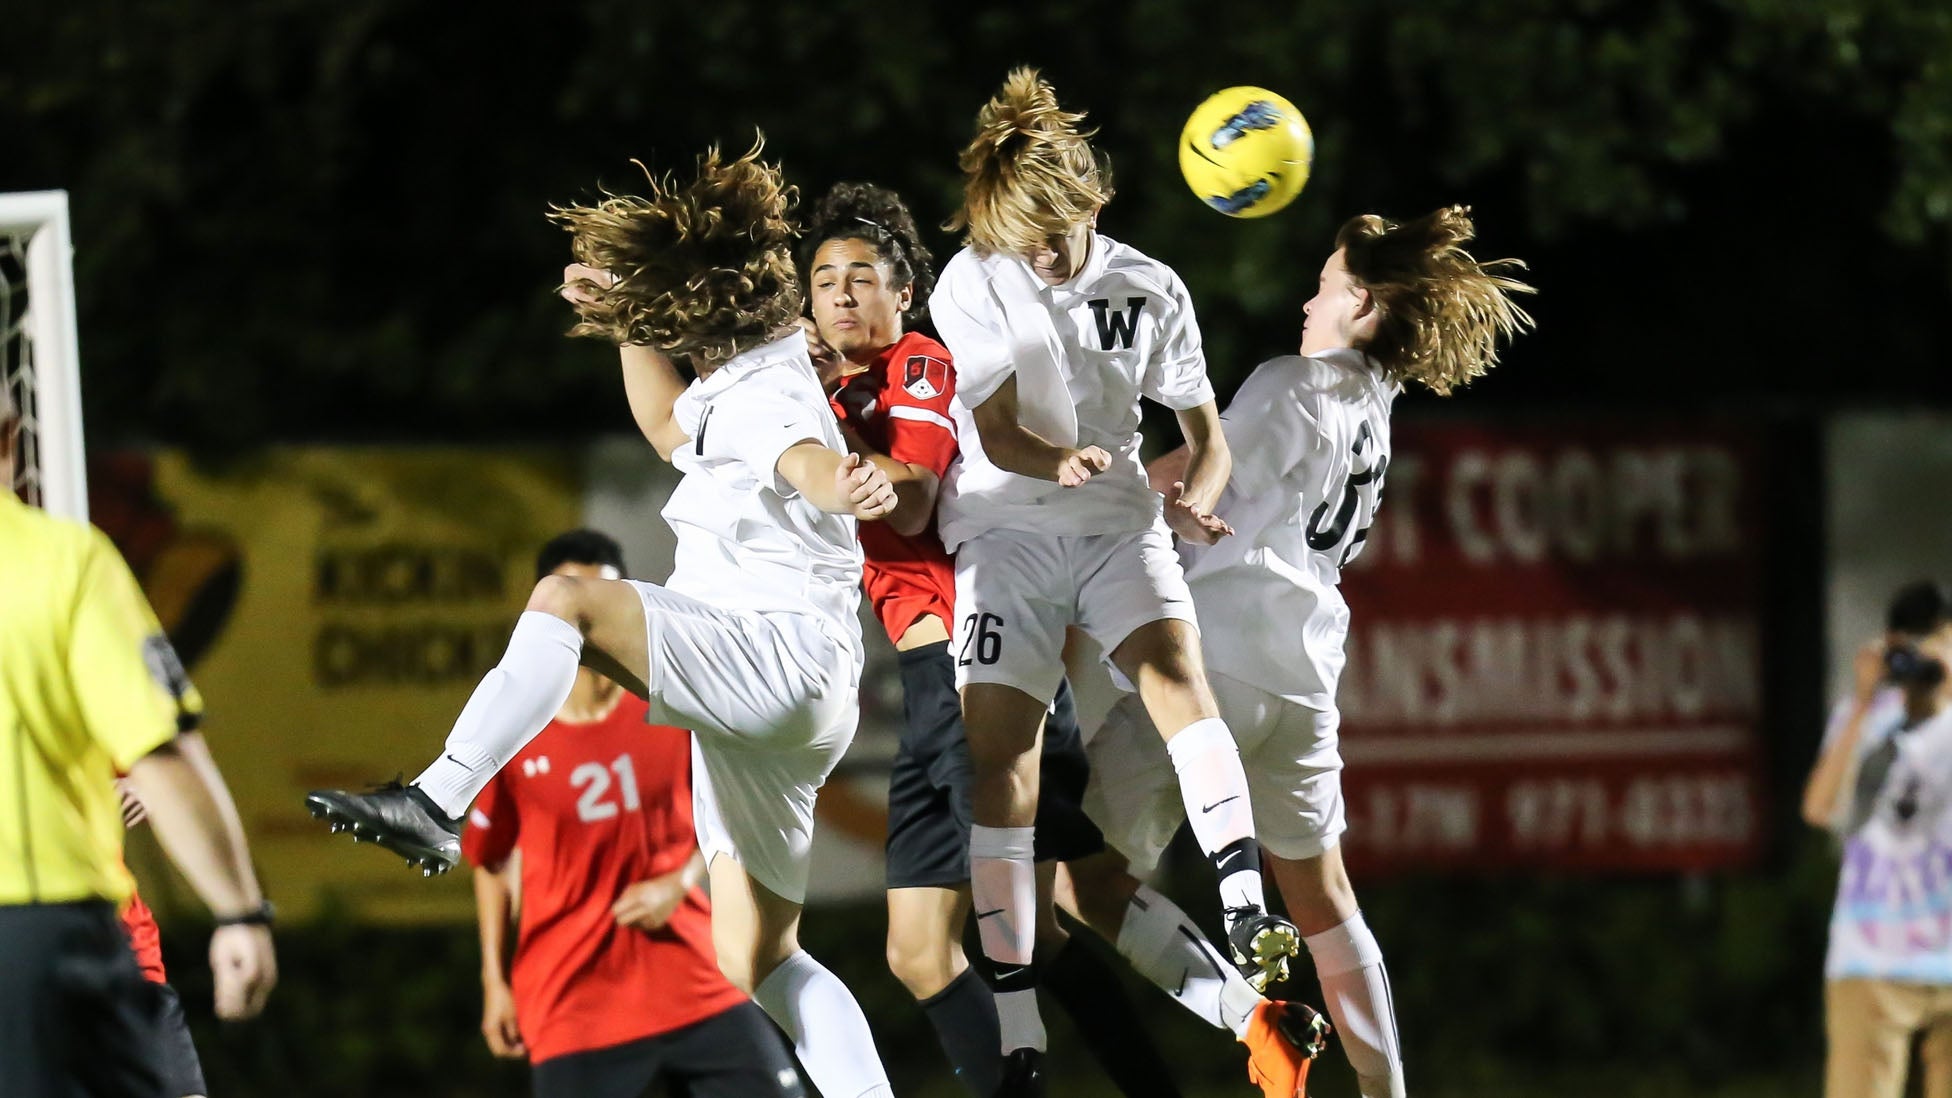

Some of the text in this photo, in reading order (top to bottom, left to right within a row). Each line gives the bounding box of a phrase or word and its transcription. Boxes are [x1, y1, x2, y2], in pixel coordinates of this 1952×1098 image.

[1087, 296, 1148, 351] W
[1447, 446, 1740, 565] COOPER
[958, 611, 1005, 667] 26
[569, 752, 641, 824] 21
